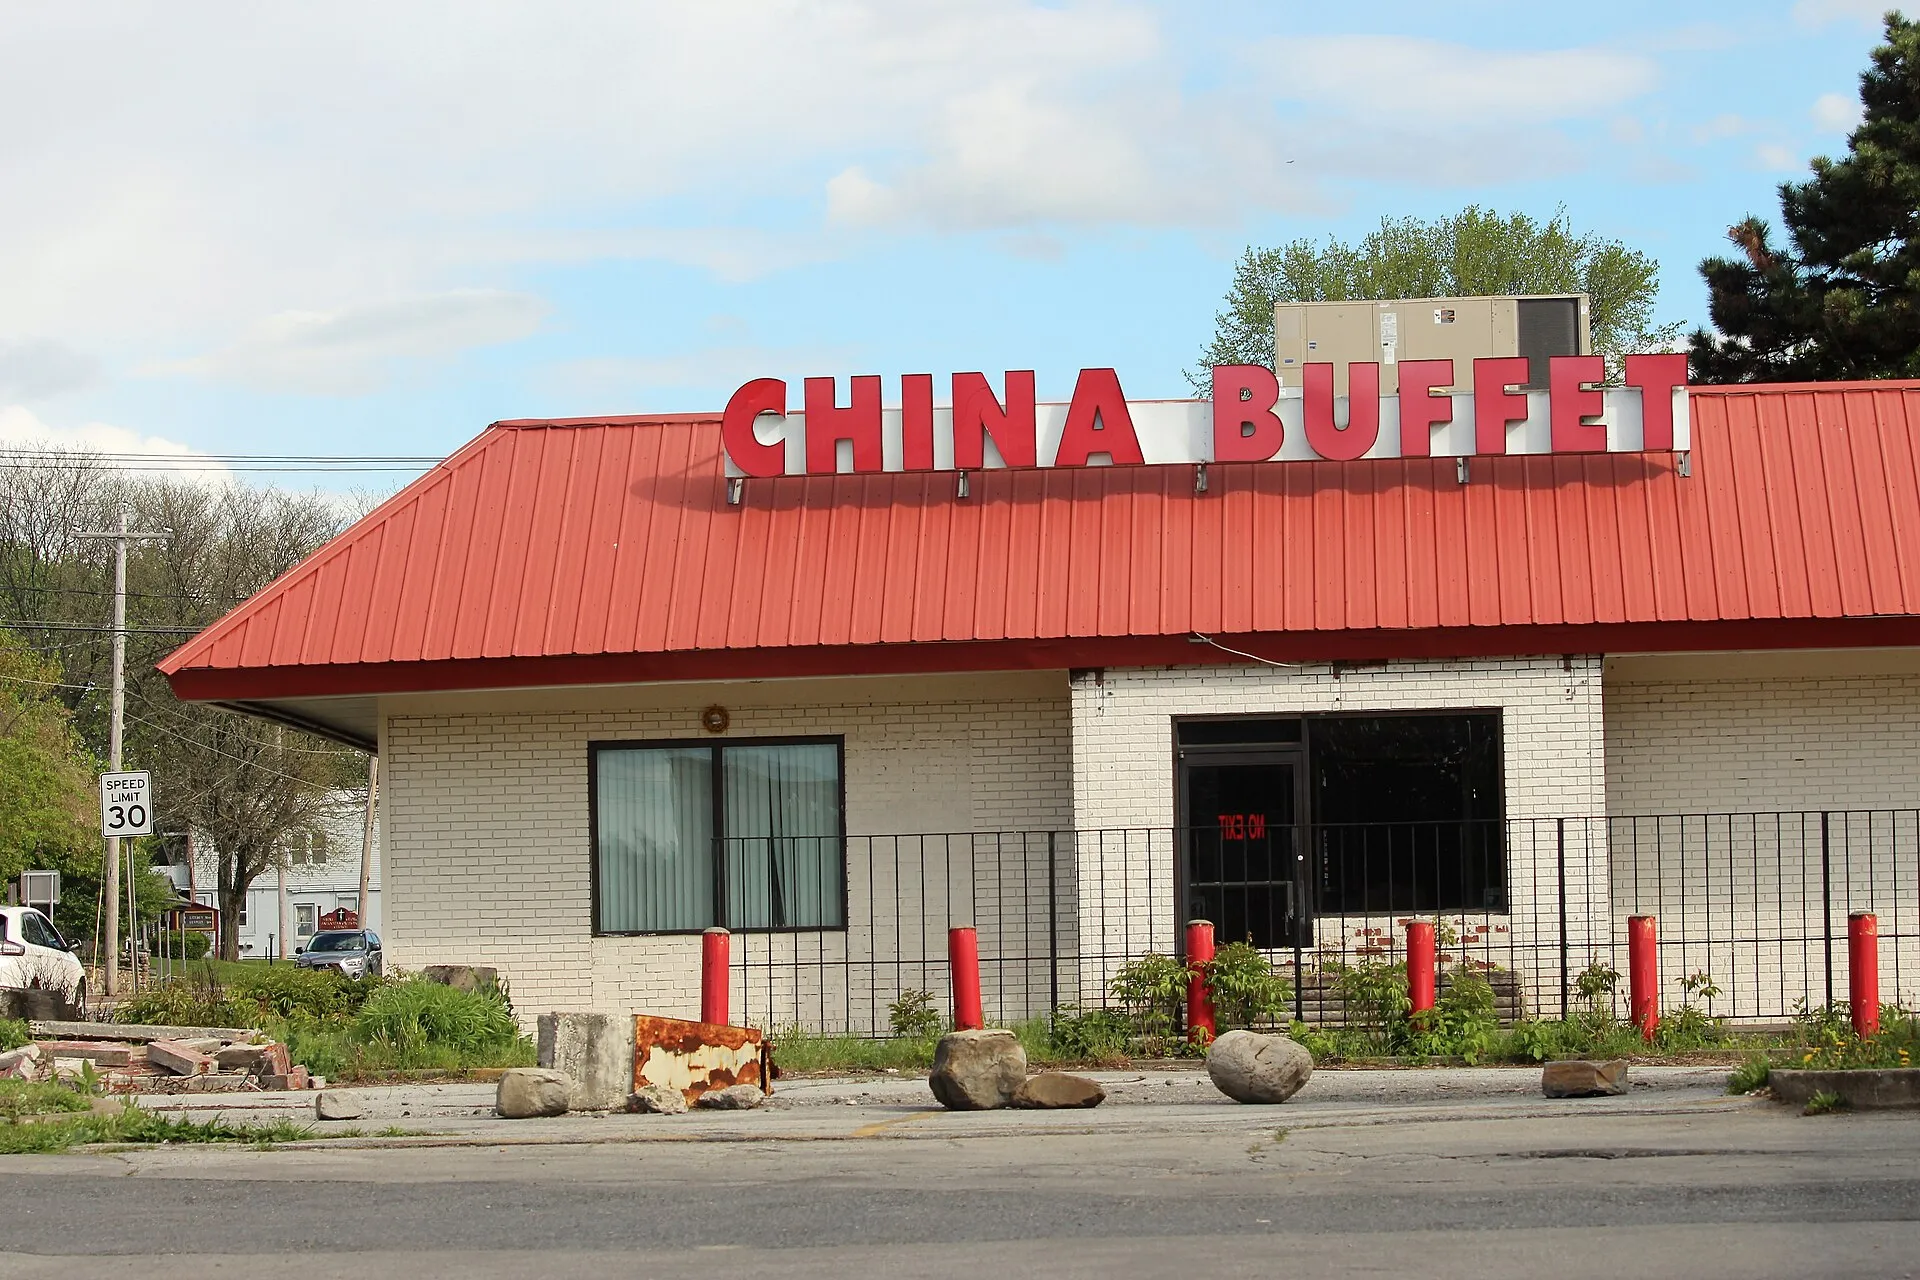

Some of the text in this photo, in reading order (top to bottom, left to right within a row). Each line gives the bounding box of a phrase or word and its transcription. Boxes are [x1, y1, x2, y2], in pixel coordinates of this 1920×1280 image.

[722, 353, 1689, 478] CHINA BUFFET
[106, 779, 145, 790] SPEED
[111, 792, 140, 803] LIMIT
[108, 804, 146, 829] 30
